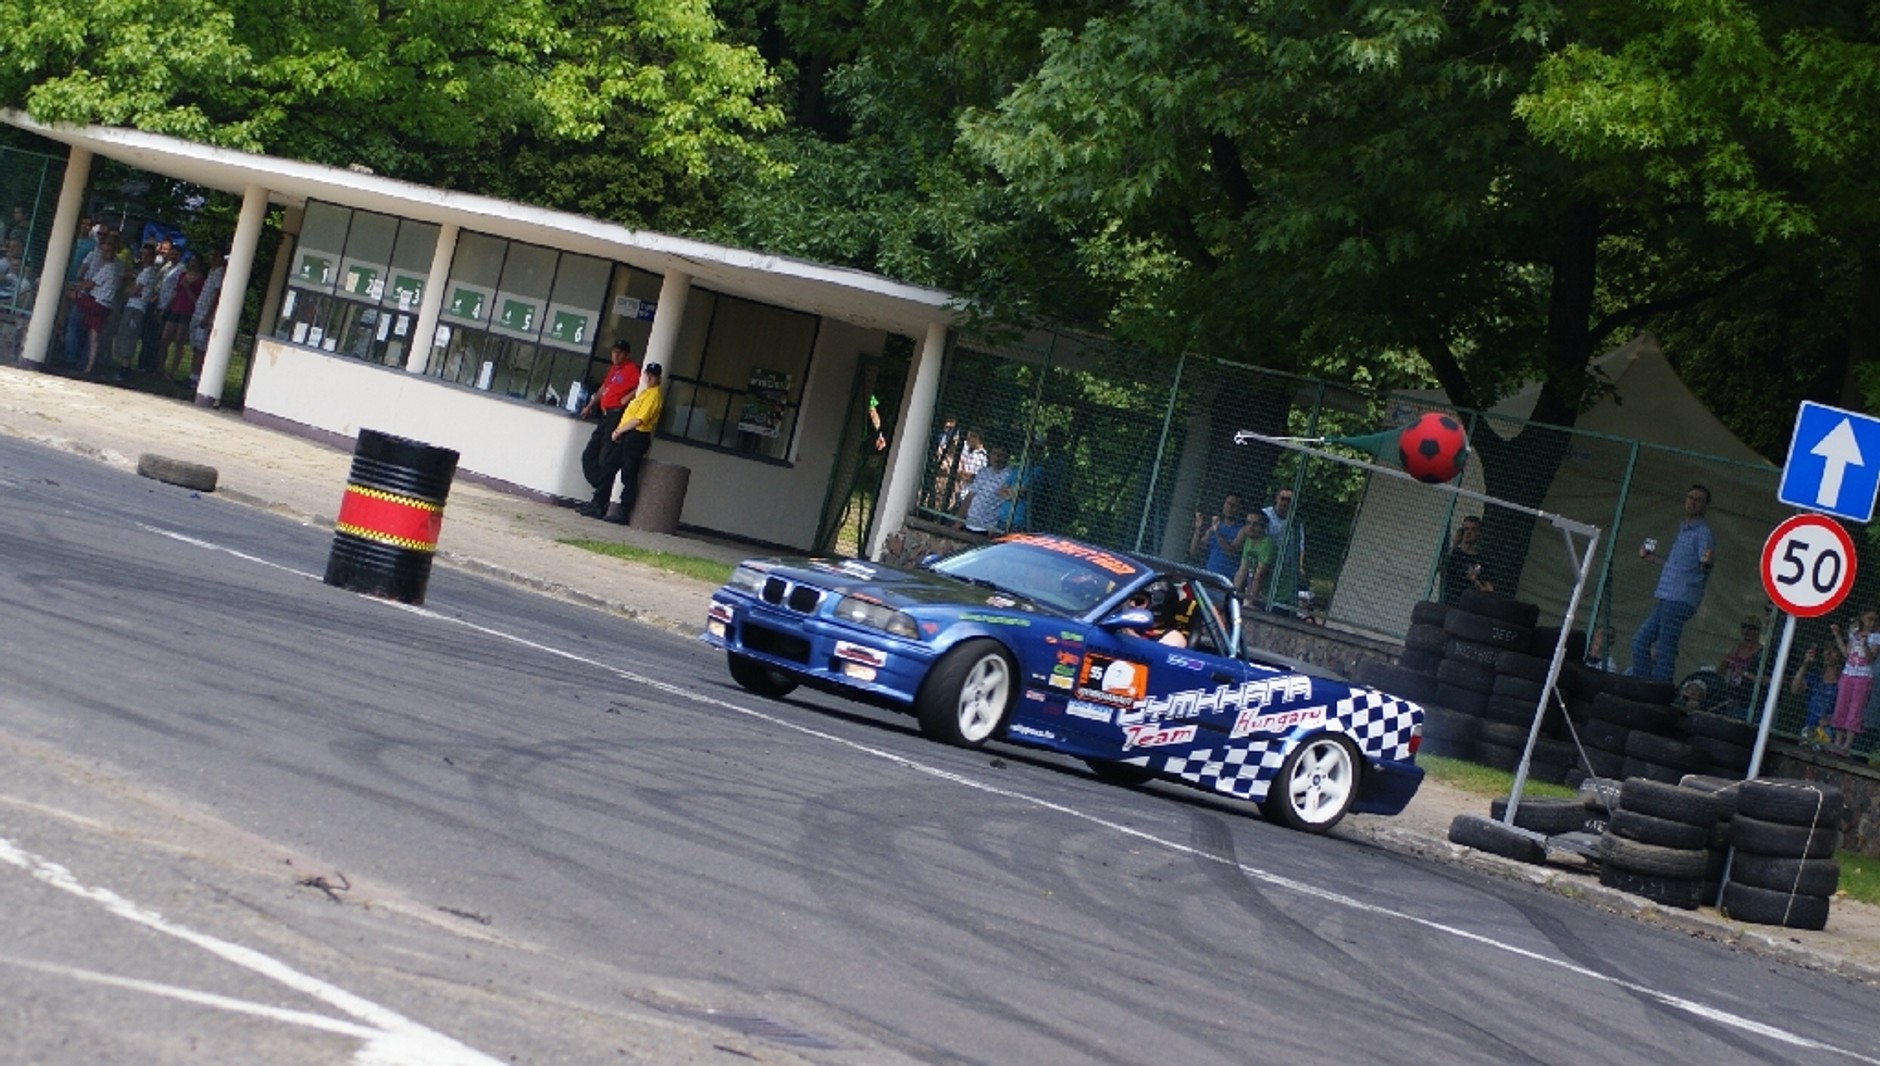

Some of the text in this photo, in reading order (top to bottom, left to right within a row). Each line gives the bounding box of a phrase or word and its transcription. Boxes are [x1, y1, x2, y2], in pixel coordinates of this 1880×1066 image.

[321, 267, 329, 284] 1
[365, 278, 374, 294] 2
[411, 289, 420, 304] 3
[472, 303, 480, 319] 4
[522, 314, 531, 330] 5
[575, 326, 583, 342] 6
[1776, 539, 1841, 594] 50
[1122, 707, 1323, 750] Team Hungary
